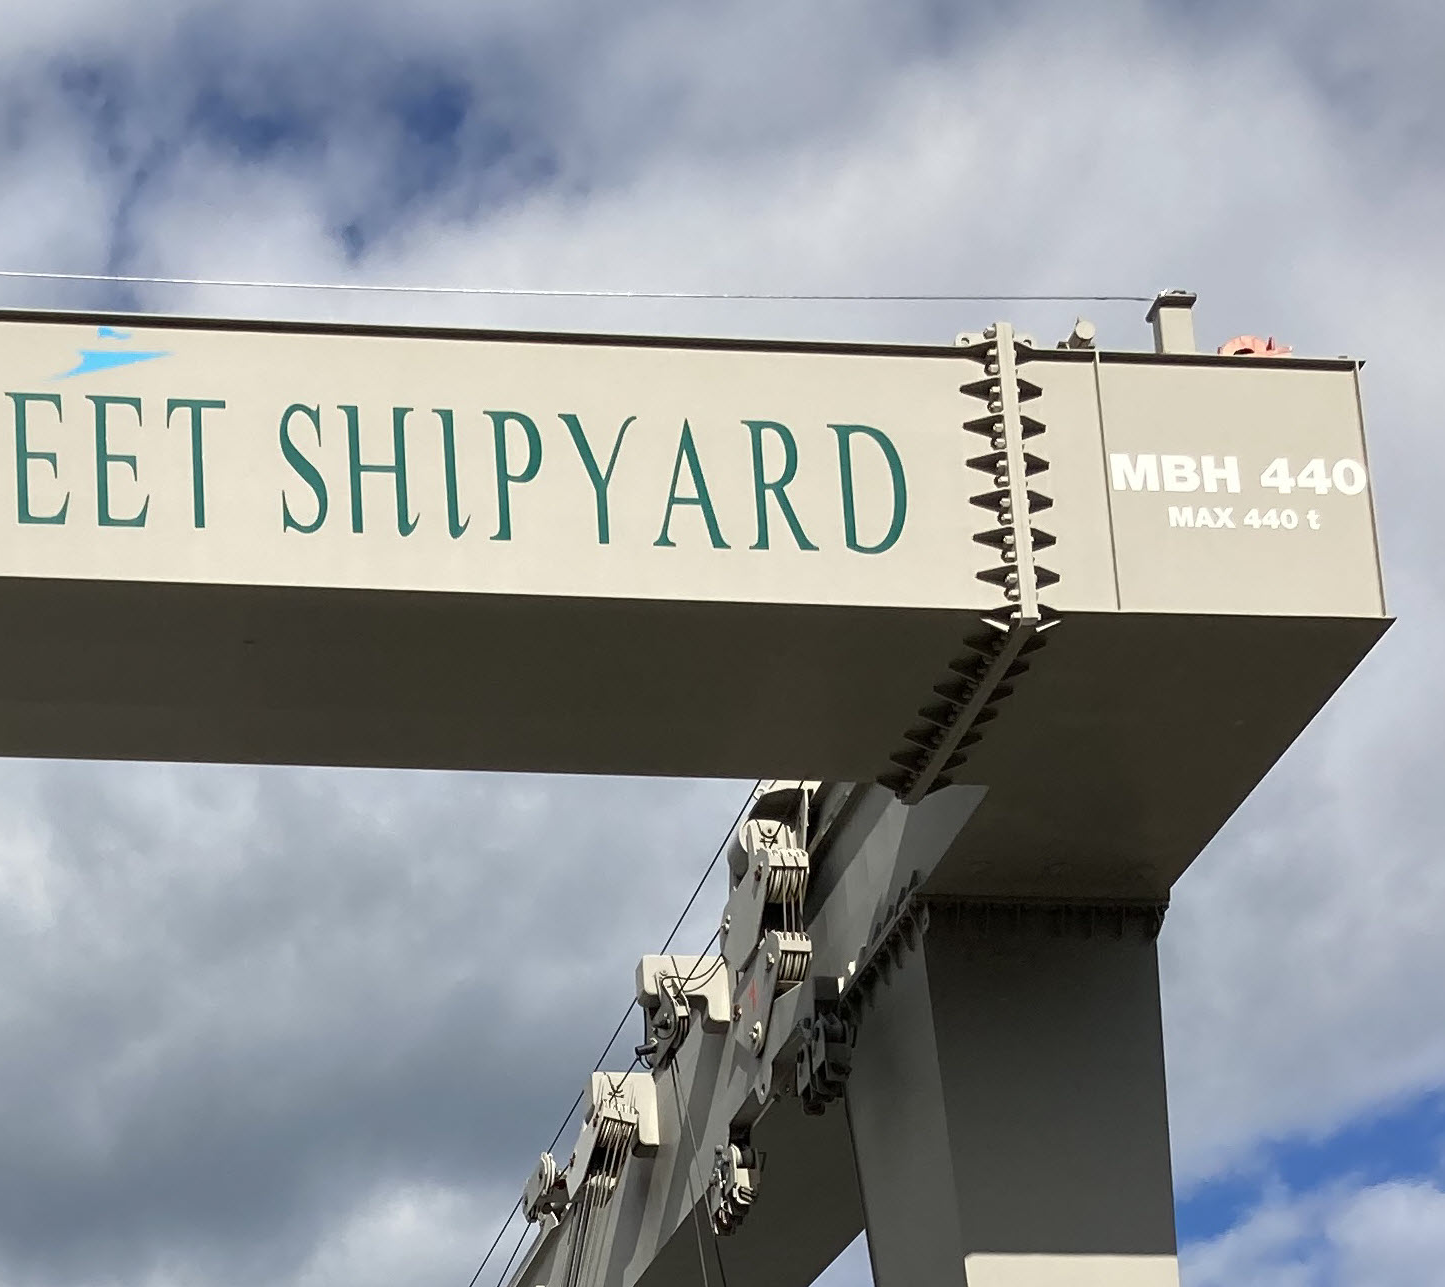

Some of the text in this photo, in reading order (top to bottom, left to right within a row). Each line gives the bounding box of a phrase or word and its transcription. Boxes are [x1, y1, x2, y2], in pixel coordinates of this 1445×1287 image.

[279, 403, 909, 555] SHIPYARD
[1108, 452, 1368, 496] MBH 440
[1167, 505, 1322, 530] MAX 440 t
